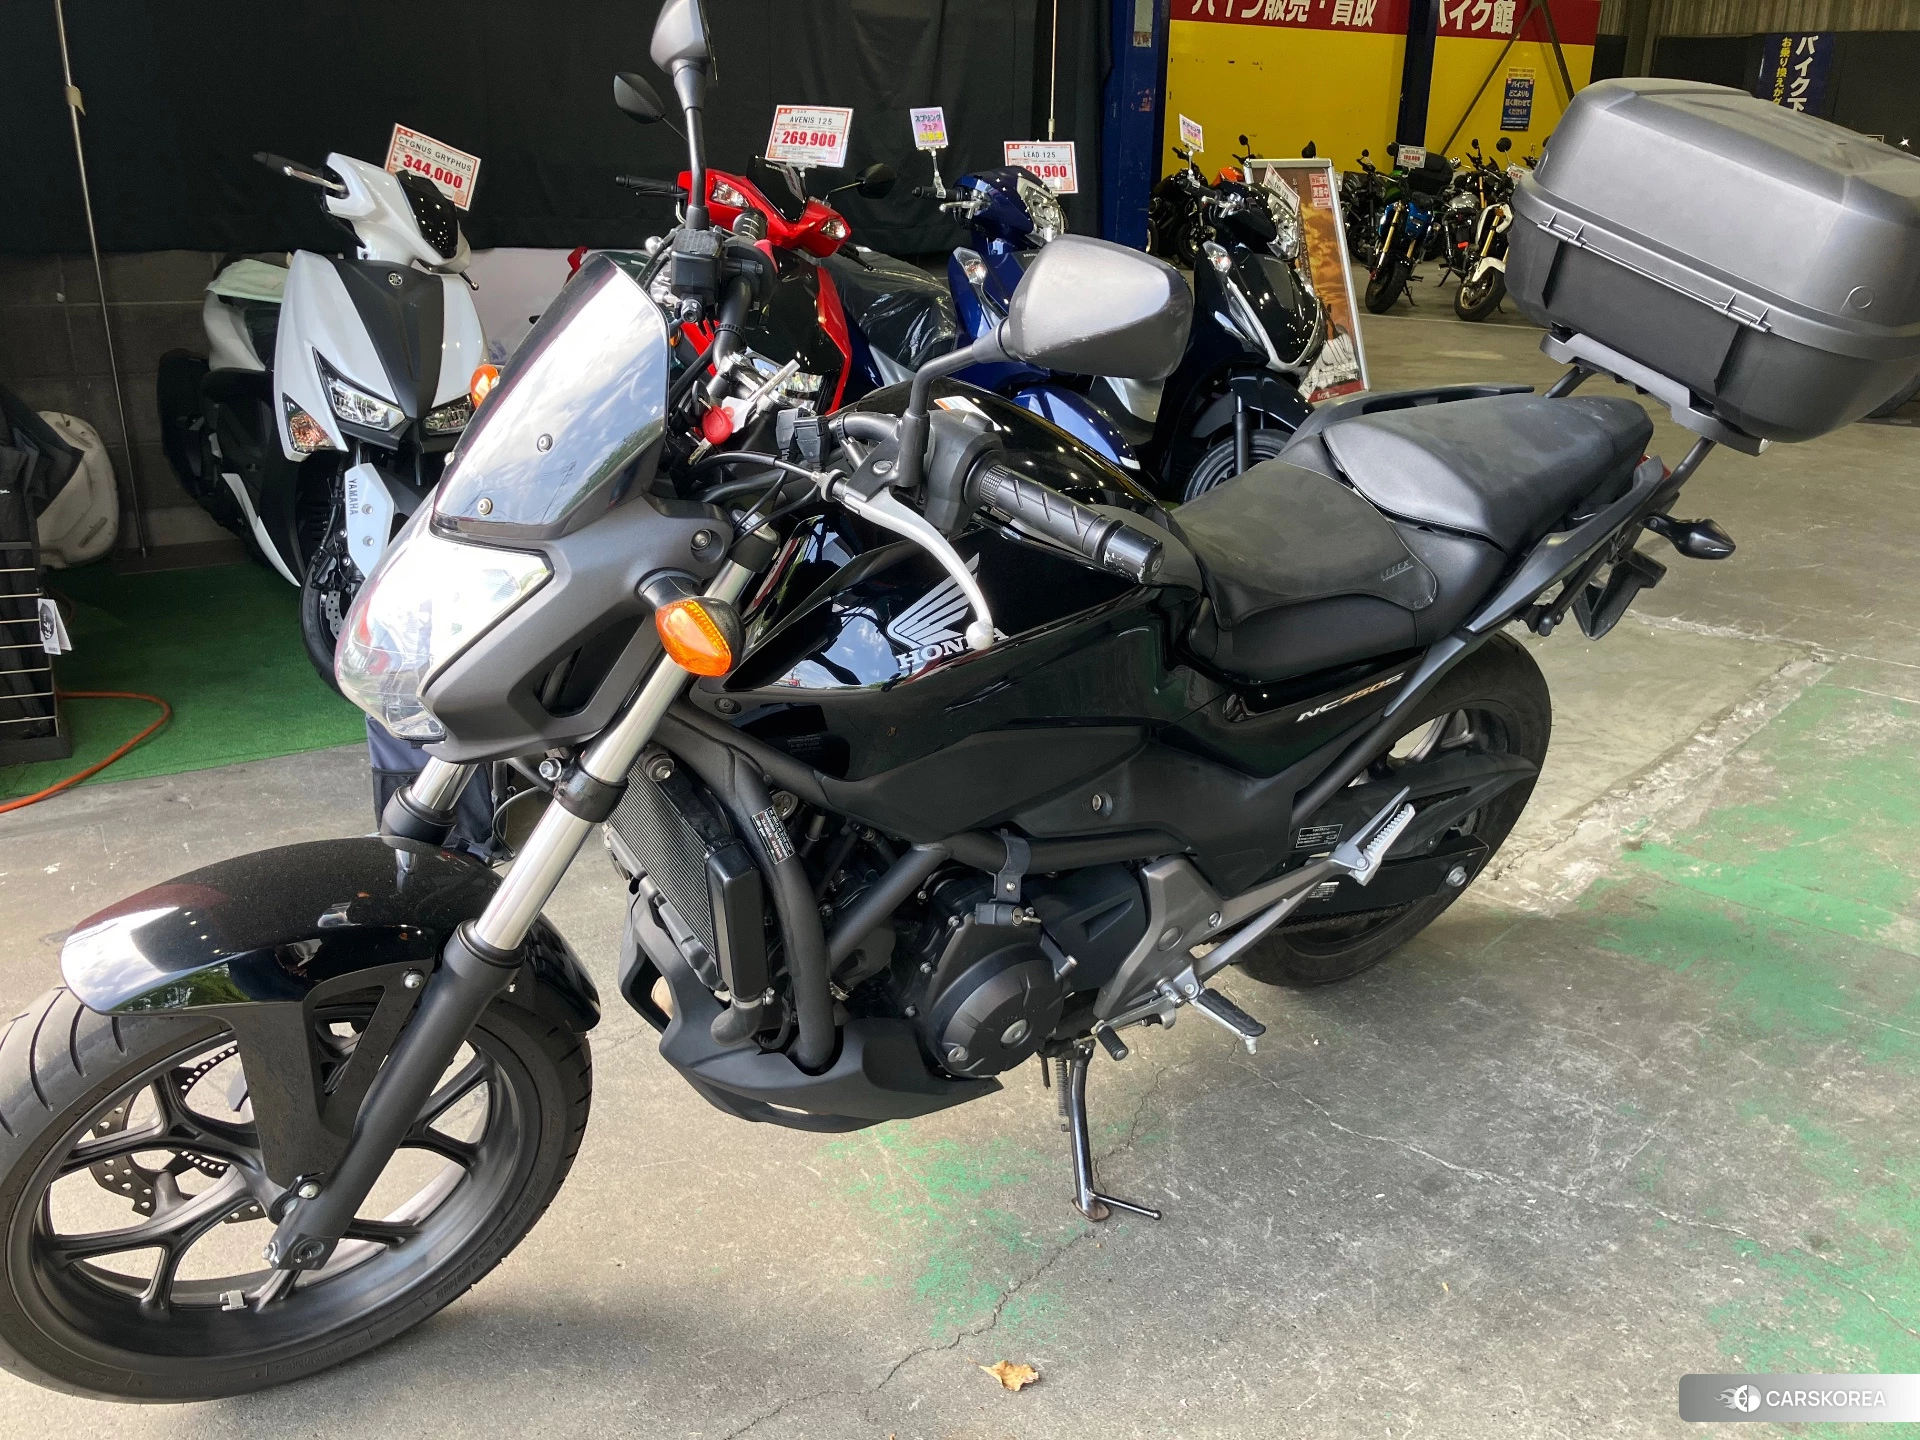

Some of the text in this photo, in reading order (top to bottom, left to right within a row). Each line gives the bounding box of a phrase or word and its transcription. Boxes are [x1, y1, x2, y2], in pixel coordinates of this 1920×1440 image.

[789, 116, 833, 126] AVENIS 125
[914, 113, 942, 123] スプリング
[922, 123, 939, 131] フェア
[781, 130, 837, 148] 269,900
[398, 136, 472, 172] CYGNUS GRYPHUS
[1023, 150, 1056, 159] LEAD 125
[403, 154, 463, 189] 344,000
[1025, 165, 1067, 179] 9,900
[347, 478, 359, 516] YAMAHA
[896, 627, 1008, 671] HONA
[1295, 671, 1406, 723] NC750S
